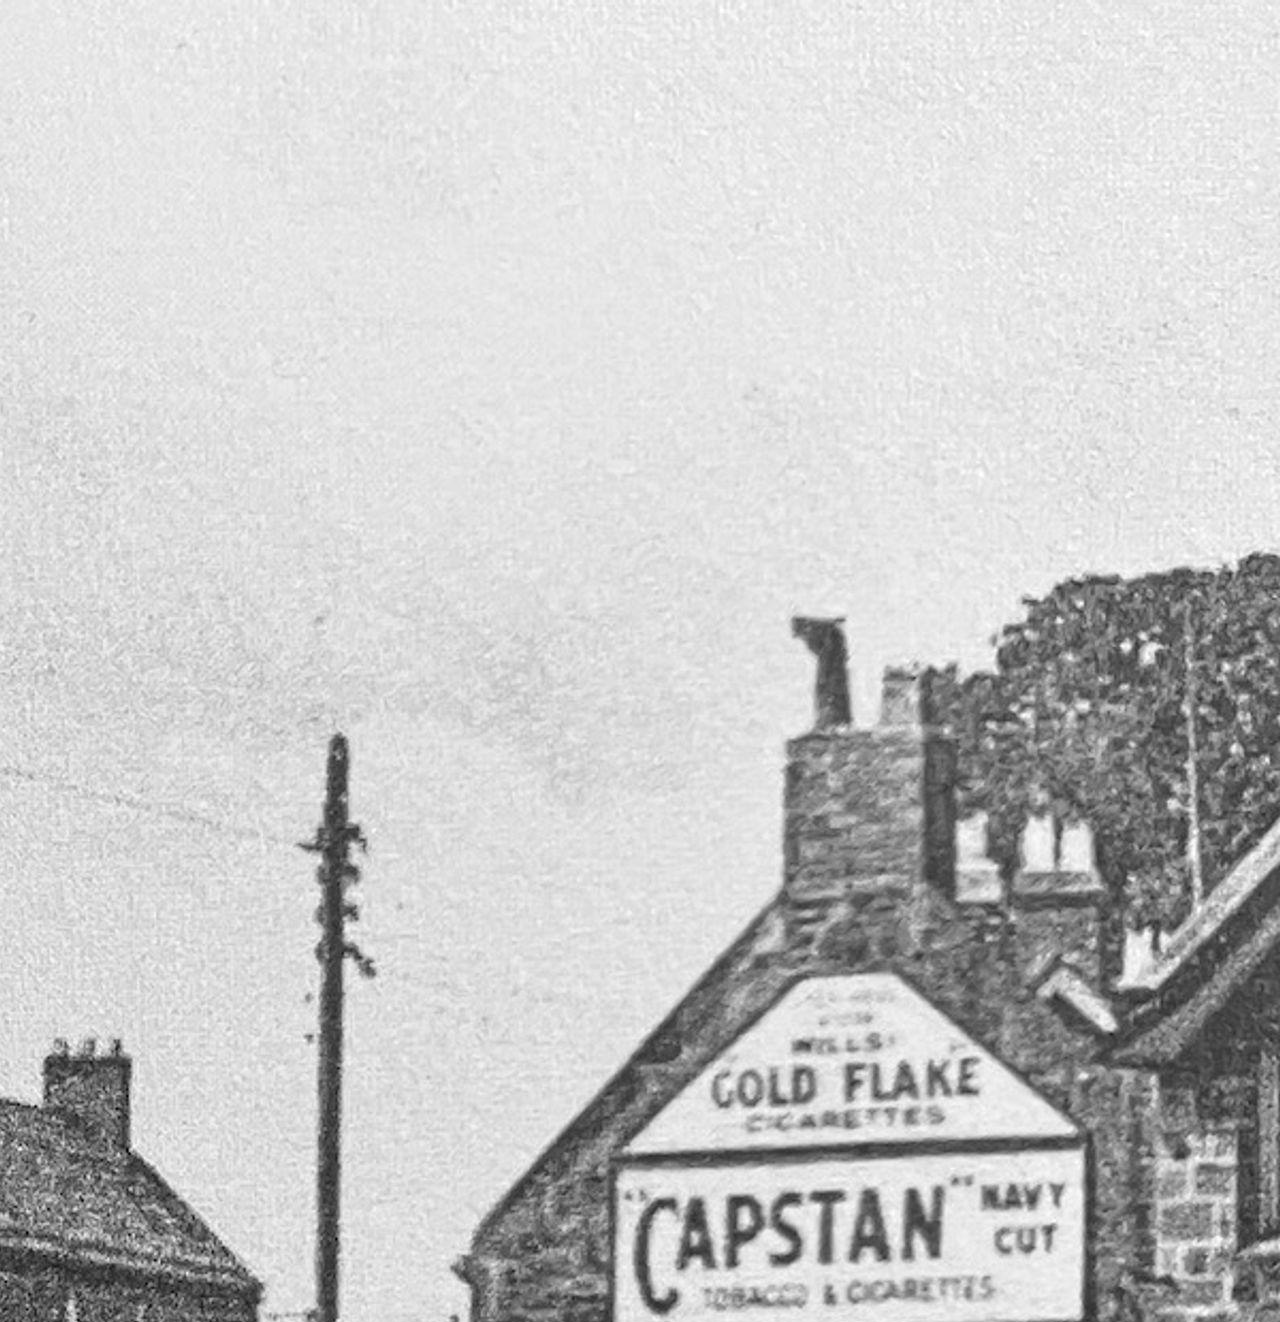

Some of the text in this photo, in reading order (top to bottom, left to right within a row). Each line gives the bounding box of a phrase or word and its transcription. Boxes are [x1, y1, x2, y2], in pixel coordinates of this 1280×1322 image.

[711, 1056, 980, 1108] GOLD FLAKE
[745, 1105, 945, 1132] CIGARETTES
[980, 1183, 1065, 1211] NAVY
[994, 1223, 1058, 1254] CUT
[702, 1282, 809, 1311] TOBACCO
[846, 1275, 996, 1305] CIGARETTES
